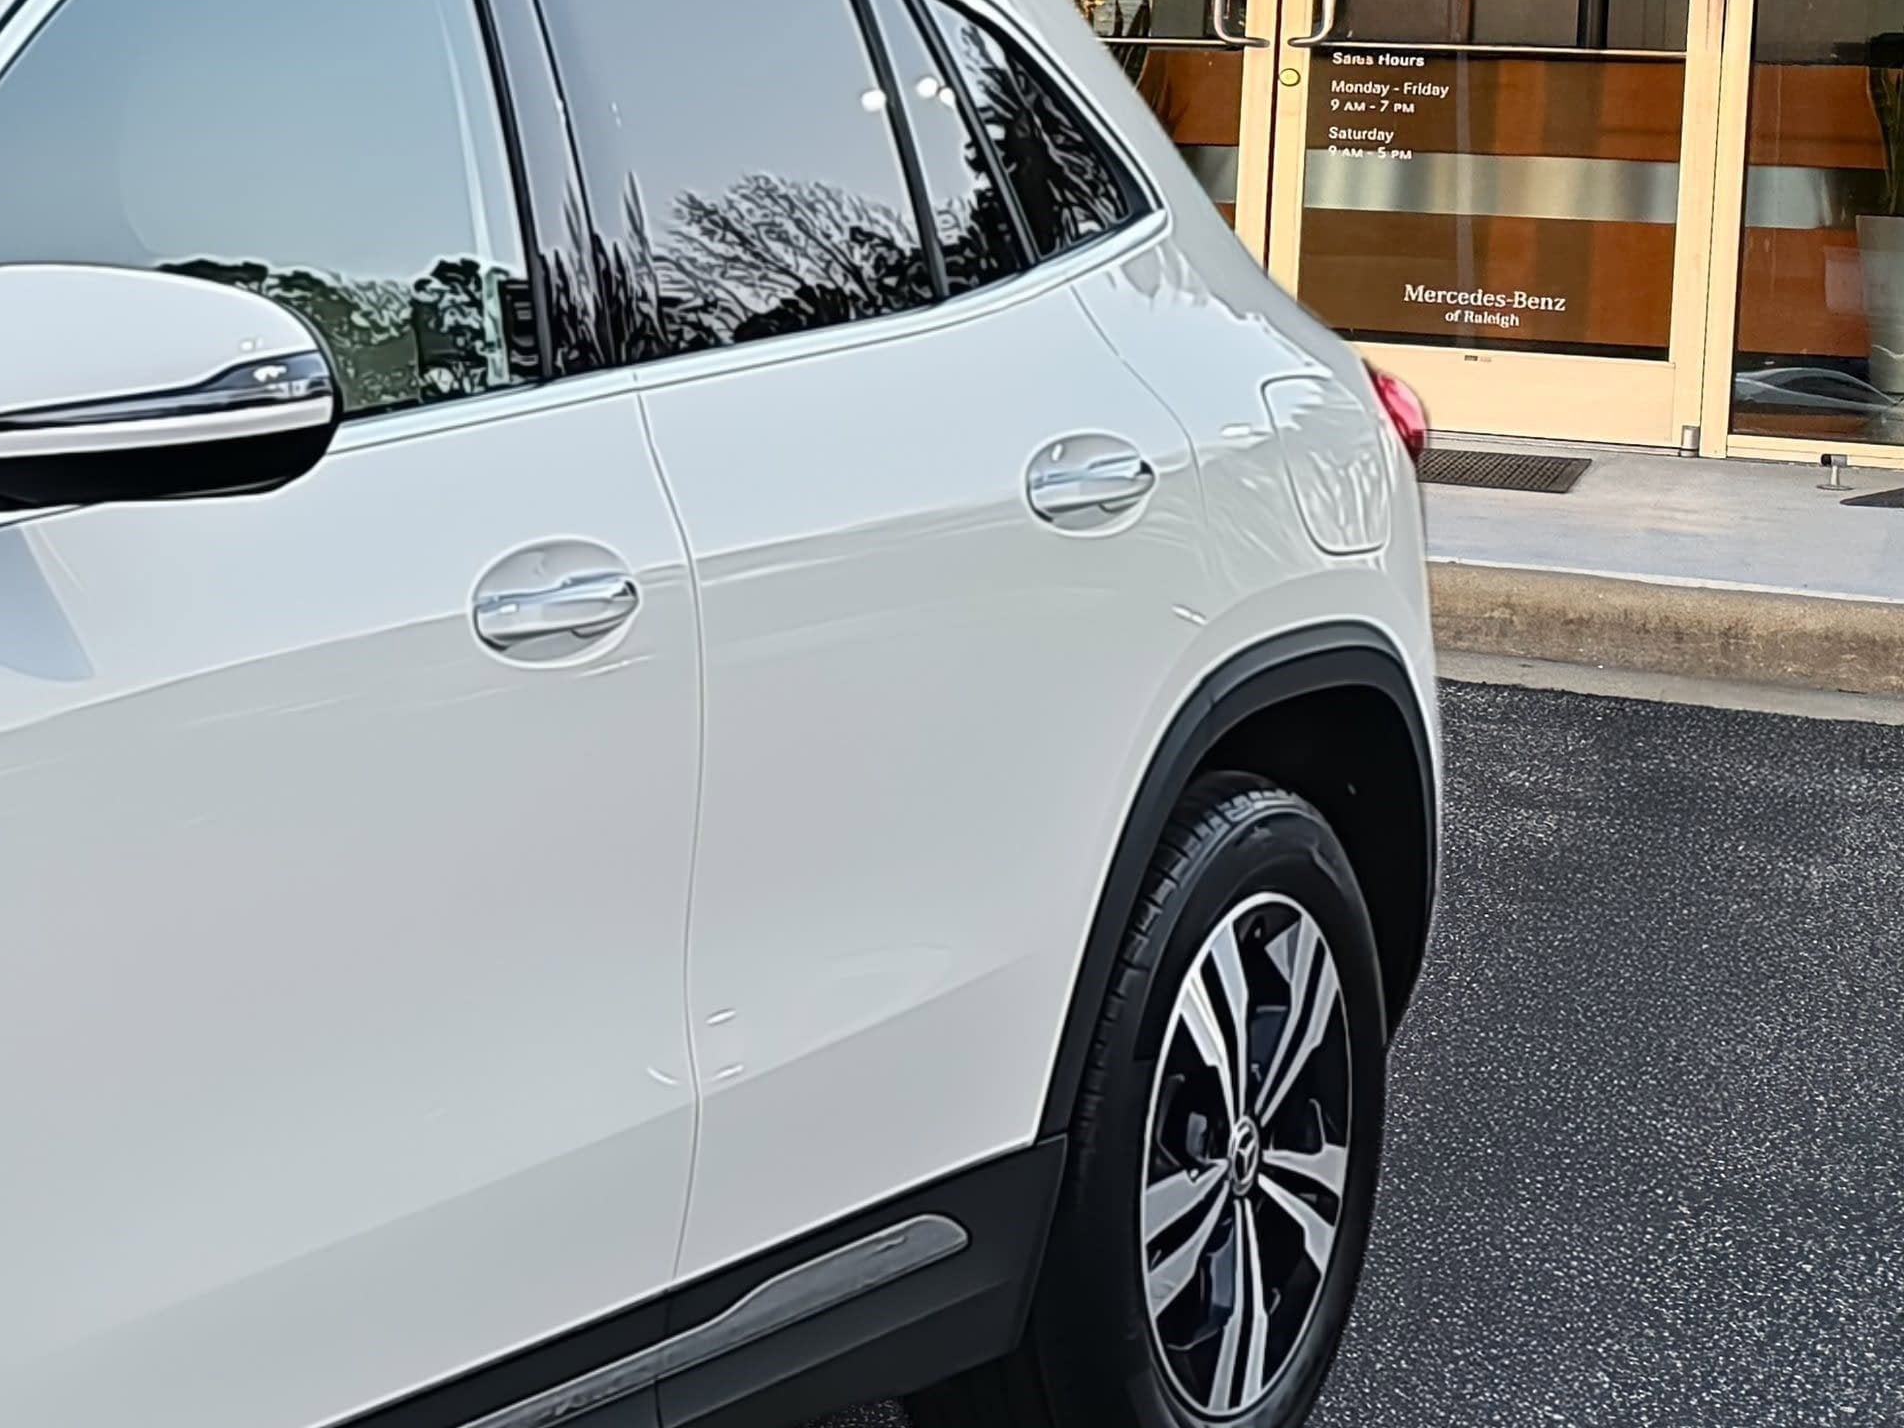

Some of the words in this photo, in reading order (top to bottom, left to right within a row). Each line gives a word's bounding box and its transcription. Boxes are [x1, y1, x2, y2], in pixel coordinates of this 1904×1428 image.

[1378, 53, 1425, 67] Hours
[1331, 80, 1390, 97] Monday
[1403, 82, 1449, 98] Friday
[1330, 99, 1340, 111] 9
[1344, 102, 1366, 111] AM
[1380, 100, 1389, 112] 7
[1394, 103, 1415, 113] PM
[1328, 126, 1394, 144] Saturday
[1328, 145, 1337, 157] 9
[1342, 148, 1364, 158] AM
[1377, 147, 1387, 159] 5
[1391, 150, 1412, 160] PM
[1403, 283, 1567, 311] Mercedes-Benz
[1445, 310, 1463, 322] of
[1464, 310, 1520, 329] Raleigh
